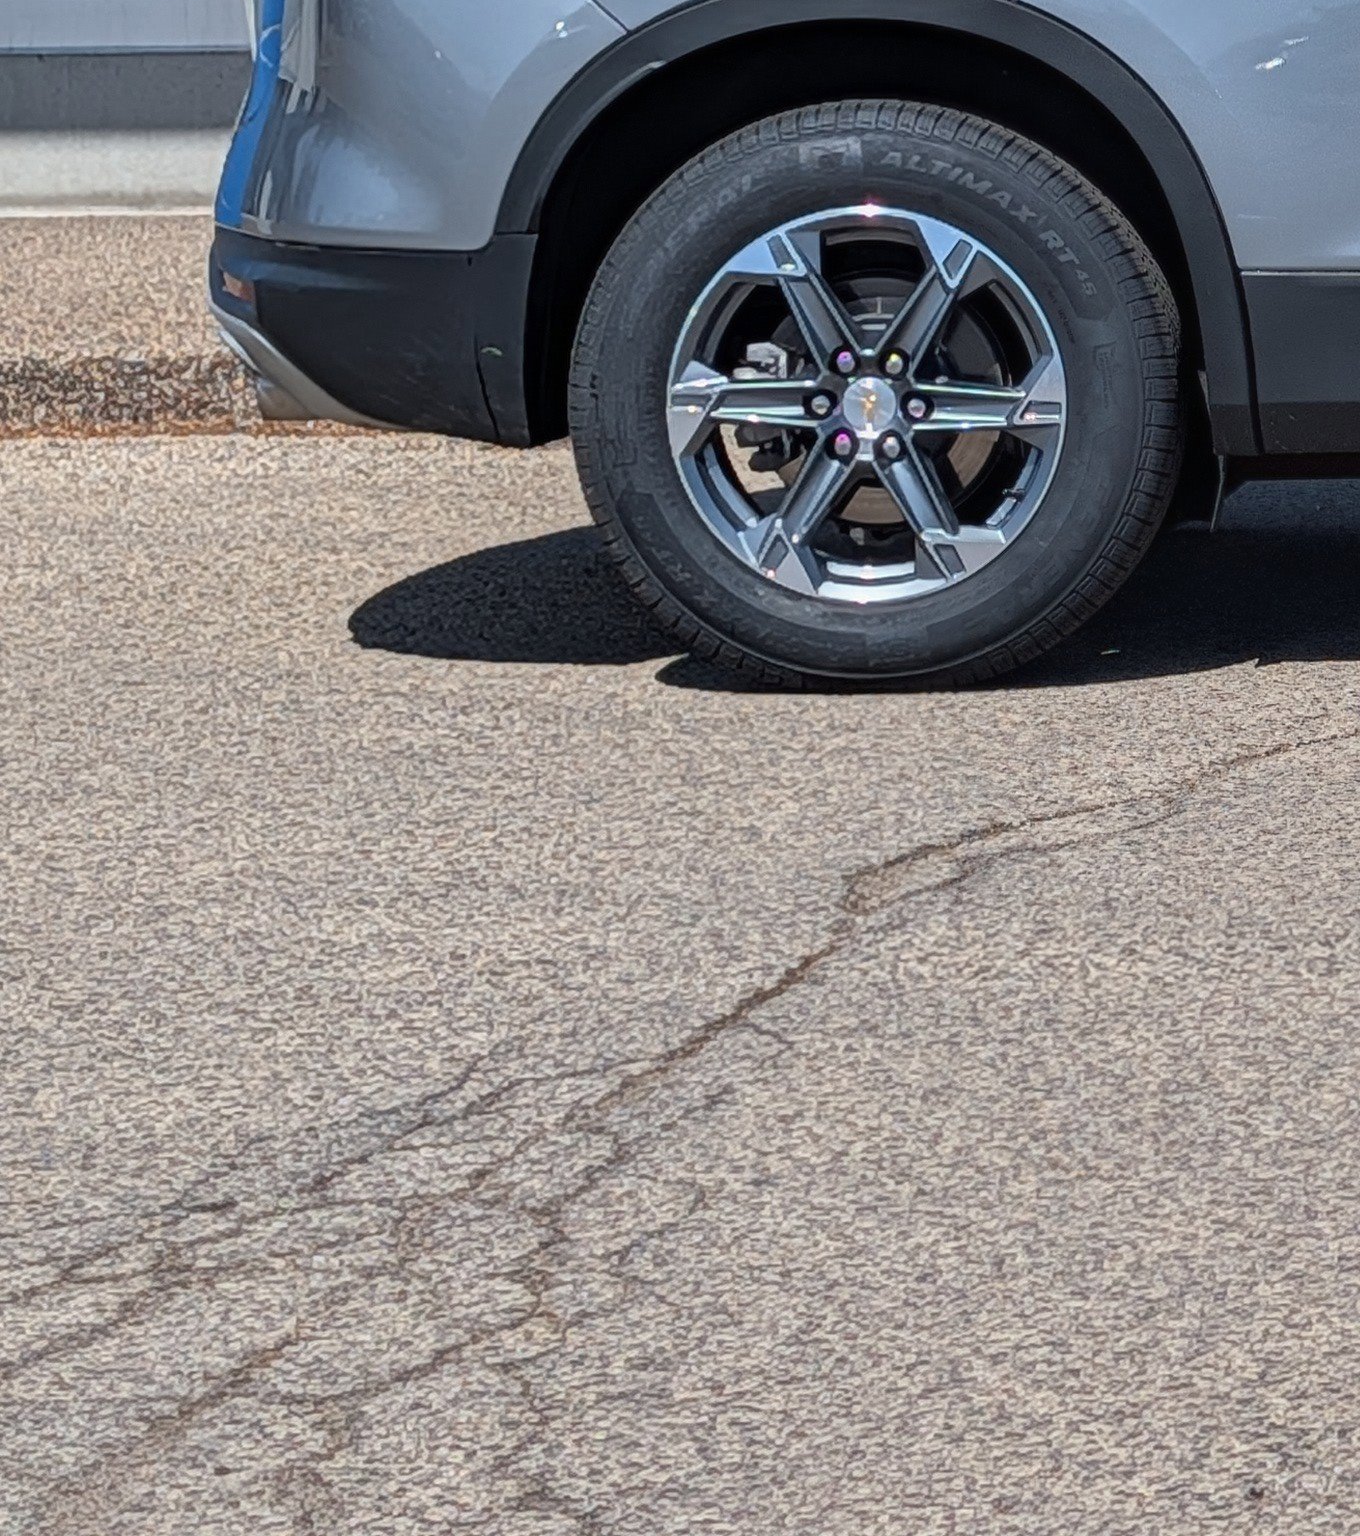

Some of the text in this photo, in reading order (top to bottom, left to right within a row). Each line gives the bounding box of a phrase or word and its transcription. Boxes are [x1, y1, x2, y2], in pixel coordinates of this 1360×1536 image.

[880, 151, 1098, 297] ALTIMAX RT 45
